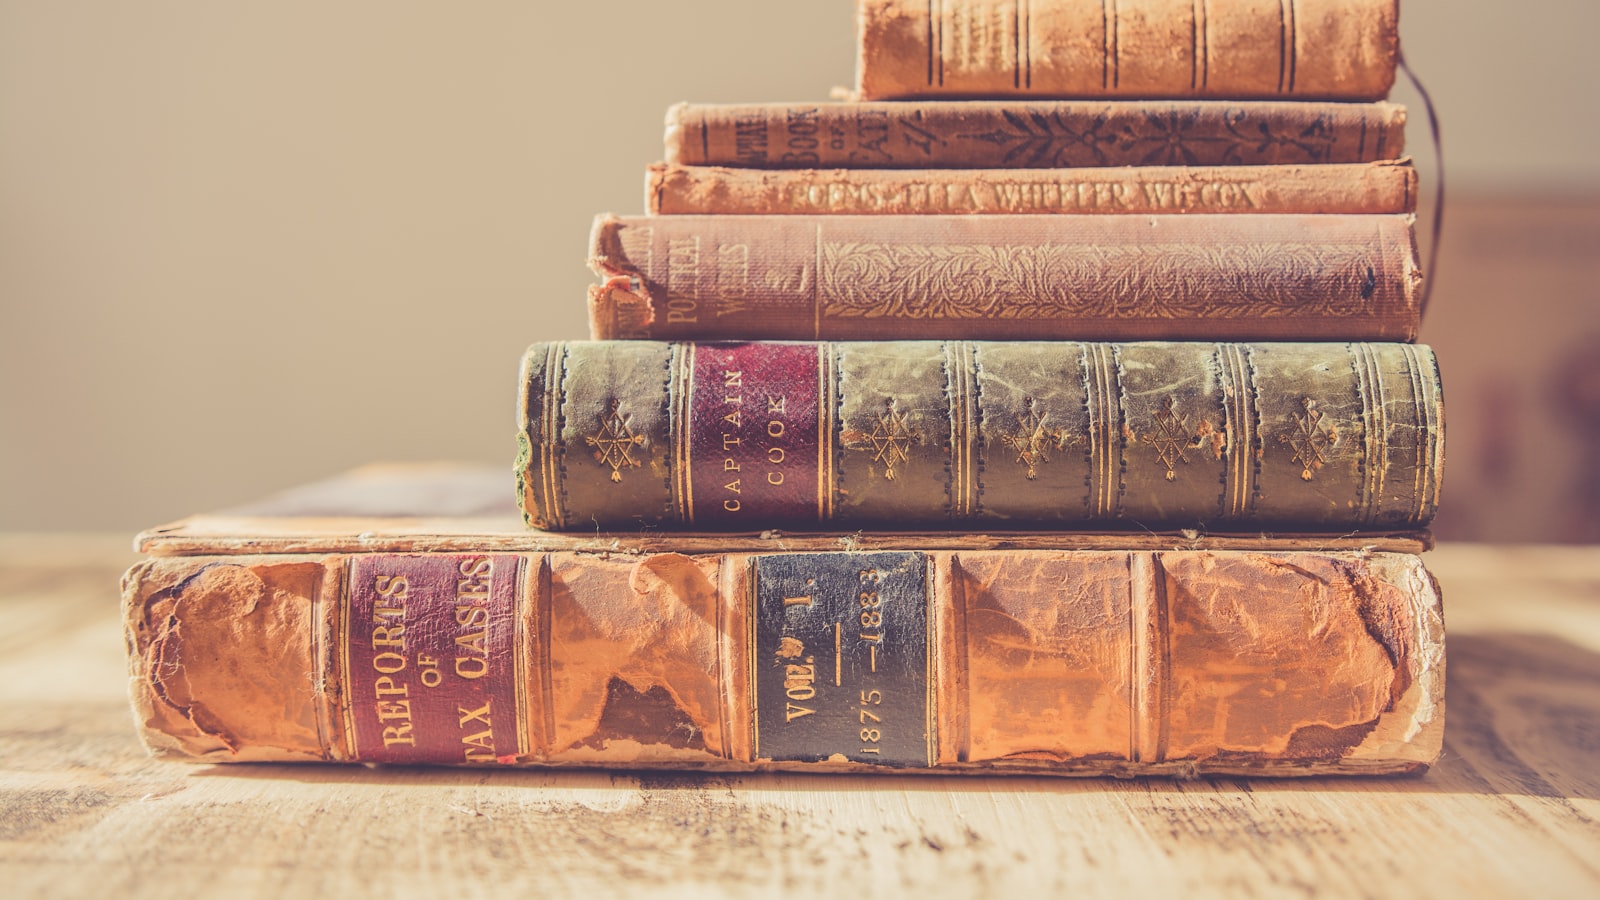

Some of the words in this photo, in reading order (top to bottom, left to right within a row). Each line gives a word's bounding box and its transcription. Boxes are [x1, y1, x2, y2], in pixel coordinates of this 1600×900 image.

[783, 107, 819, 166] BOOK
[667, 236, 700, 323] POETICAL
[716, 243, 749, 318] WORKS
[724, 370, 742, 512] CAPTAIN
[767, 395, 786, 486] COOK
[372, 575, 416, 748] REPORTS
[455, 557, 494, 680] CASES
[417, 652, 443, 688] OF
[458, 702, 497, 764] TAX
